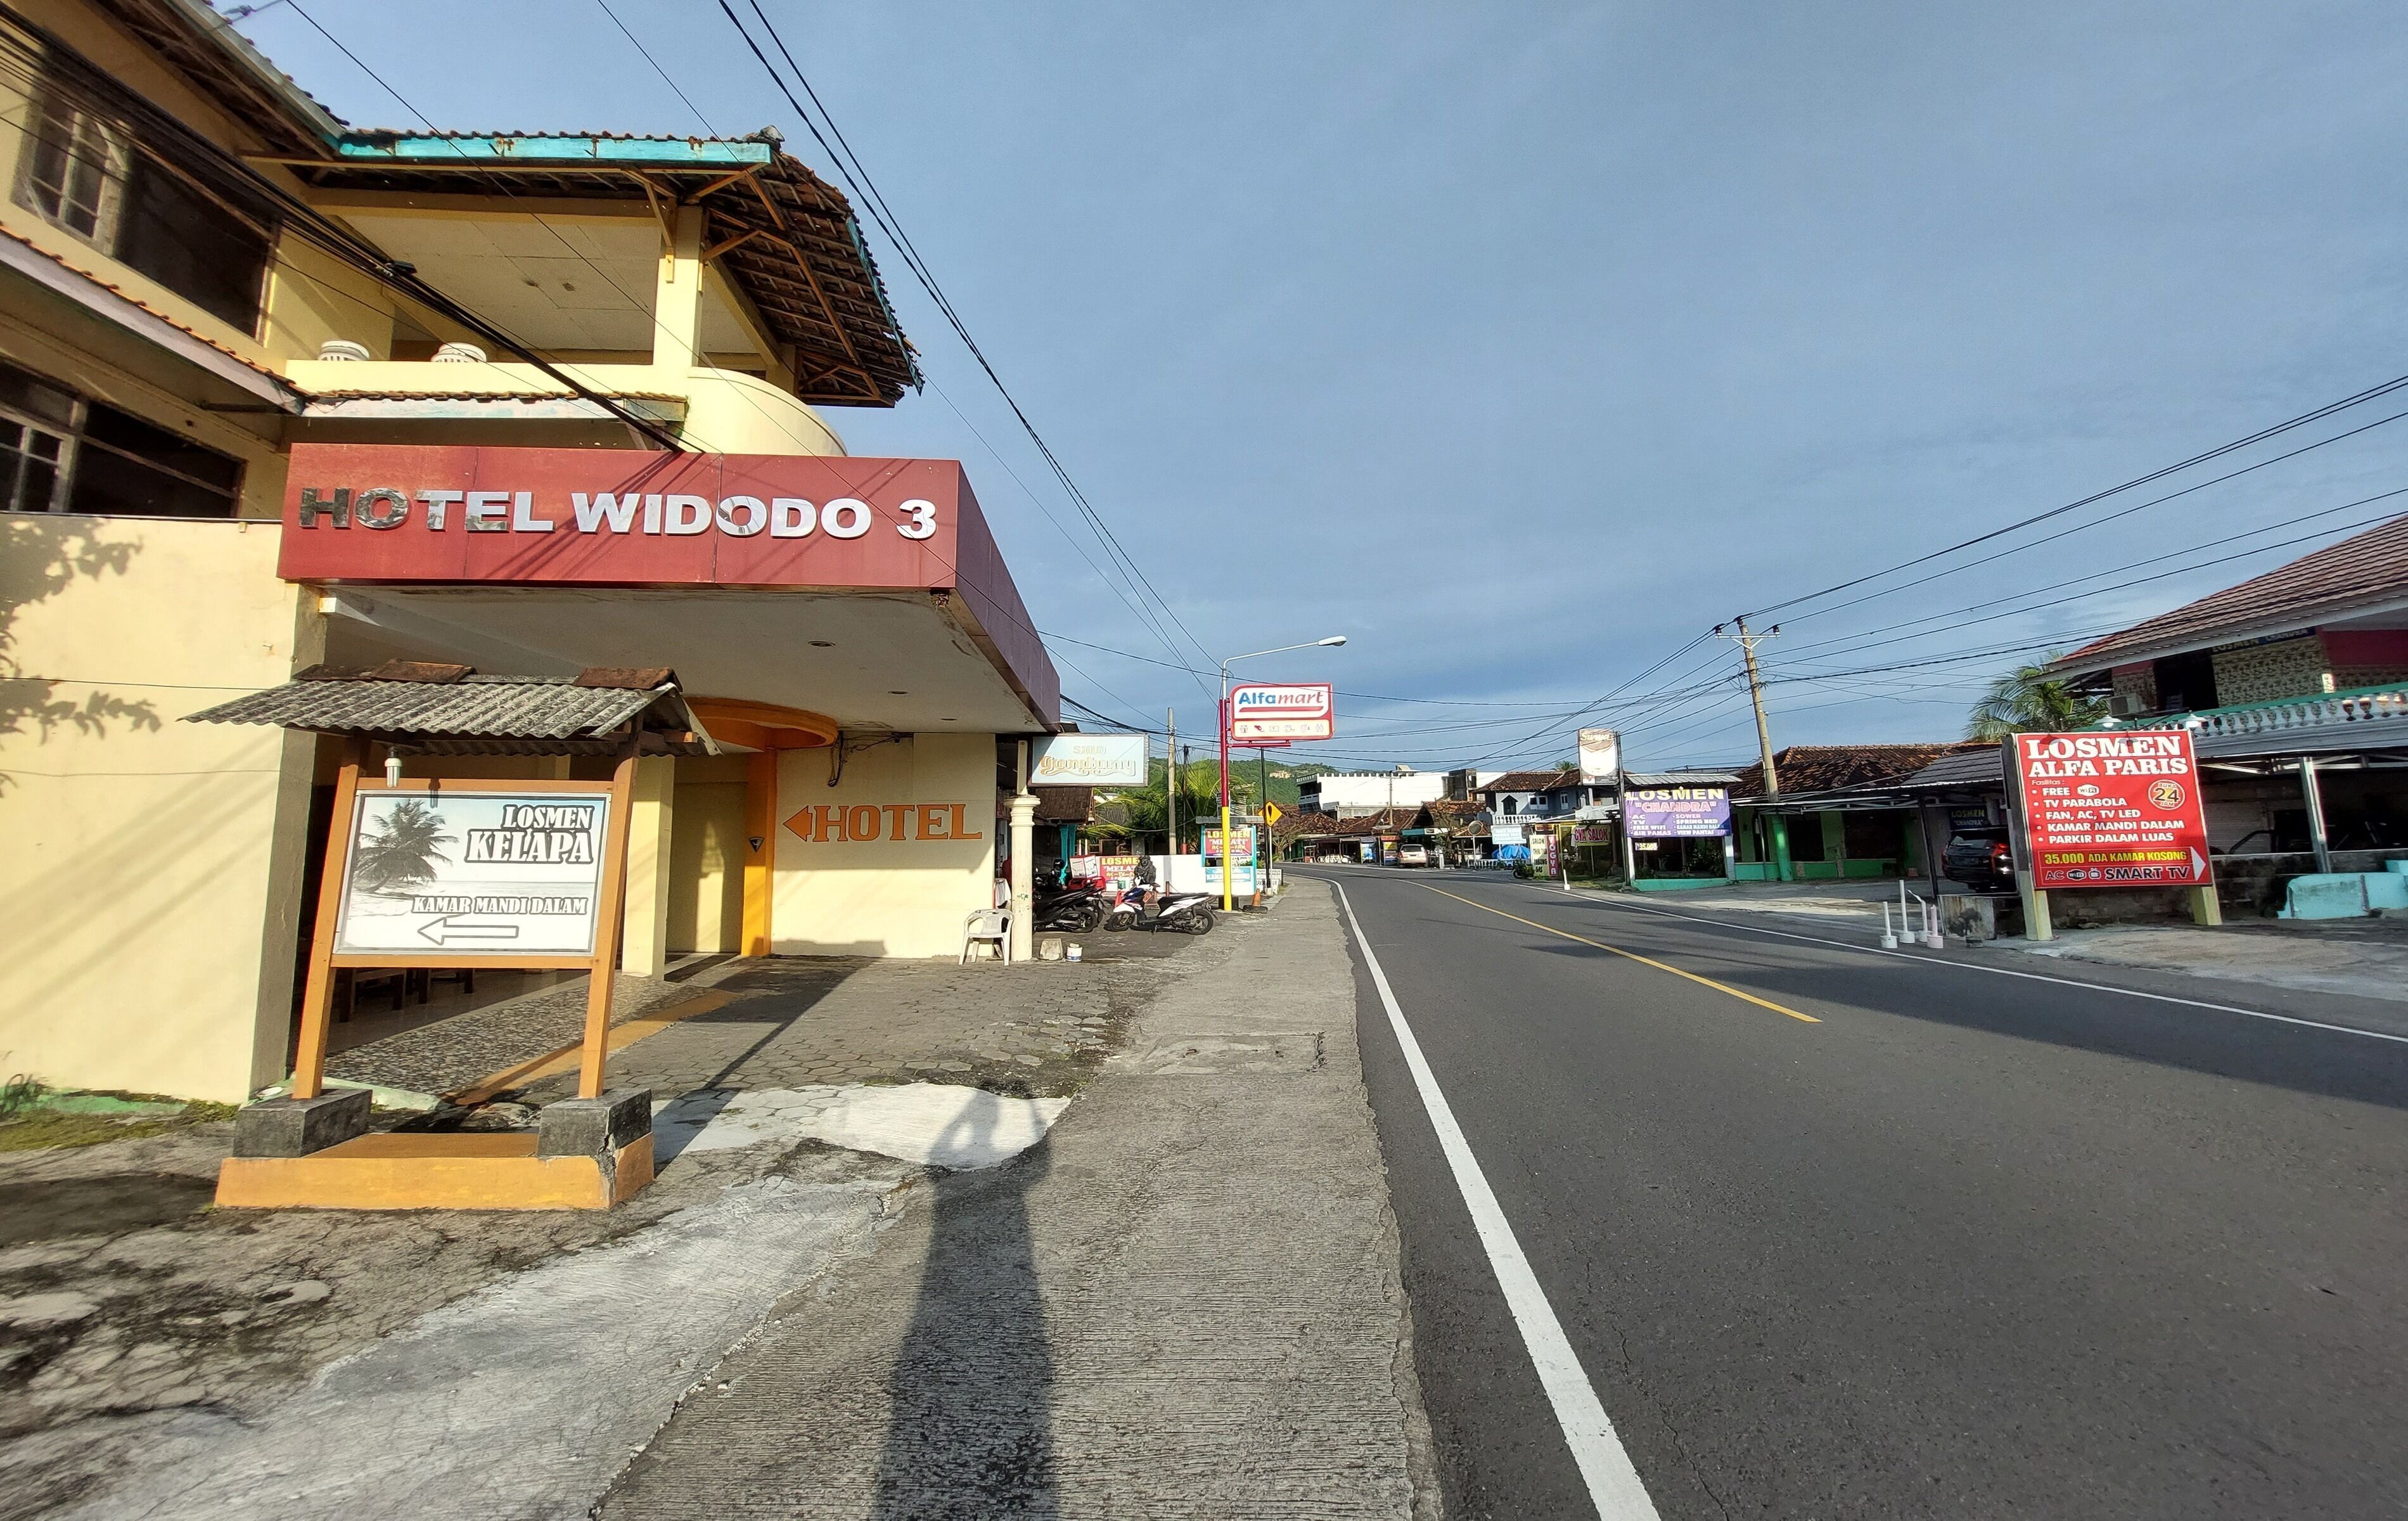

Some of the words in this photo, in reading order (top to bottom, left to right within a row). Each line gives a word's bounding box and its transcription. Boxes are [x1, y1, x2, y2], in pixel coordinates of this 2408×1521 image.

[299, 487, 556, 534] HOTEL
[572, 492, 873, 539] WIDODO
[896, 499, 937, 541] 3
[1238, 691, 1324, 705] Alfamart
[2026, 736, 2181, 759] LOSMEN
[2028, 760, 2099, 777] ALFA
[2103, 757, 2189, 775] PARIS
[1625, 788, 1724, 800] LOSMEN
[2042, 787, 2070, 796] FREE
[2155, 788, 2179, 802] 24
[1634, 801, 1717, 812] "CHANDRA"
[2043, 800, 2059, 808] TV
[2062, 798, 2128, 807] PARABOLA
[501, 804, 594, 829] LOSMEN
[1951, 809, 1985, 818] LOSMEN
[2046, 811, 2074, 821] FAN,
[2077, 811, 2097, 820] AC,
[2099, 810, 2115, 818] TV
[2118, 809, 2141, 818] LED
[812, 804, 983, 842] HOTEL
[2047, 823, 2091, 832] KAMAR
[2094, 821, 2137, 830] MANDI
[2141, 820, 2185, 830] DALAM
[1589, 828, 1608, 841] SALON
[2049, 835, 2093, 844] PARKIR
[2096, 833, 2139, 842] DALAM
[2142, 832, 2174, 842] LUAS
[464, 828, 593, 863] KELAPA
[1101, 857, 1139, 865] LOSME
[2044, 853, 2084, 864] 35.000
[2088, 853, 2108, 863] ADA
[2110, 852, 2144, 863] KAMAR
[2147, 851, 2187, 861] KOSONG
[2046, 870, 2064, 880] AC
[2104, 866, 2163, 880] SMART
[2166, 866, 2189, 879] TV
[412, 896, 472, 914] KAMAR
[474, 897, 528, 914] MANDI
[530, 897, 588, 915] DALAM
